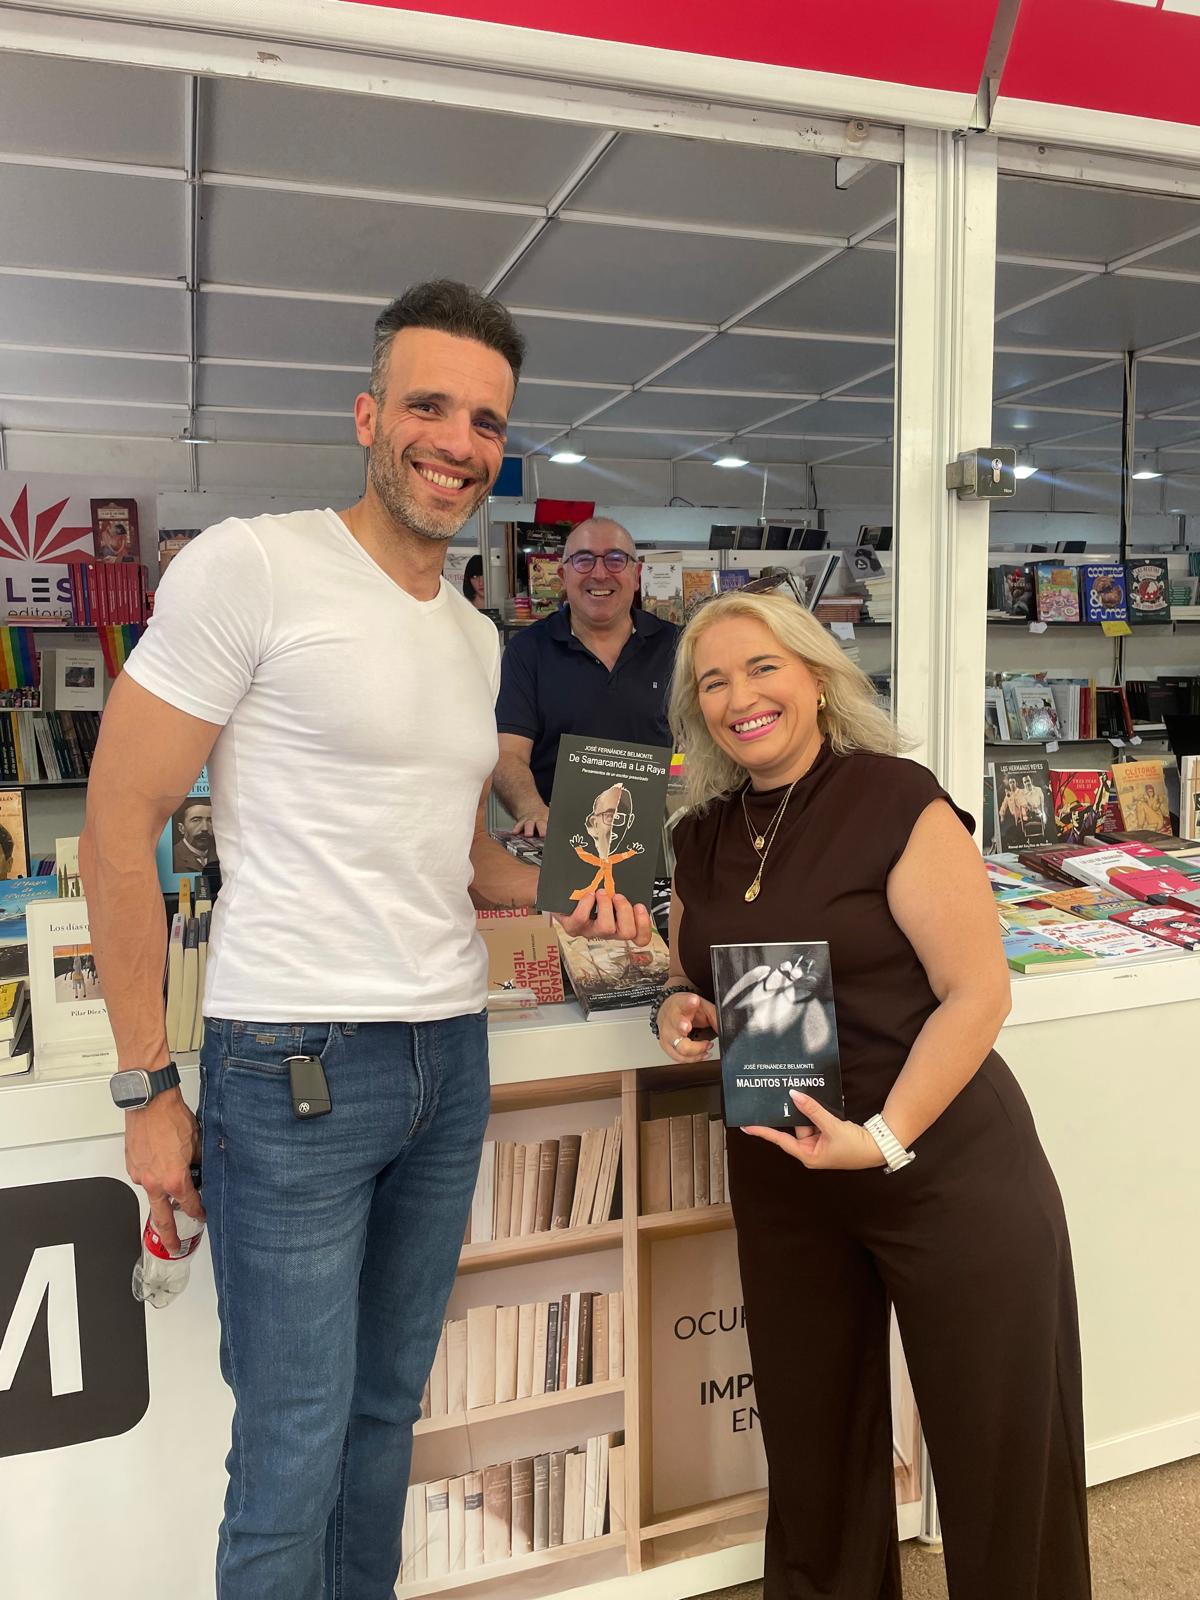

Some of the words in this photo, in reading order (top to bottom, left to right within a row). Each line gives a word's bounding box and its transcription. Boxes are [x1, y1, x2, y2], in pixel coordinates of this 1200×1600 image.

[627, 750, 653, 760] BELMONTE
[569, 753, 580, 763] De
[581, 755, 627, 769] Samarcanda
[635, 762, 645, 772] La
[646, 764, 666, 776] Raya
[1008, 764, 1031, 772] HERMANOS
[50, 924, 65, 932] Los
[66, 922, 84, 931] días
[537, 960, 550, 977] DE
[546, 945, 564, 1002] HAZAÑAS
[526, 961, 541, 1003] MALO
[539, 979, 552, 1002] LOS
[736, 1078, 781, 1088] MALDITOS
[781, 1076, 825, 1087] TÁBANOS
